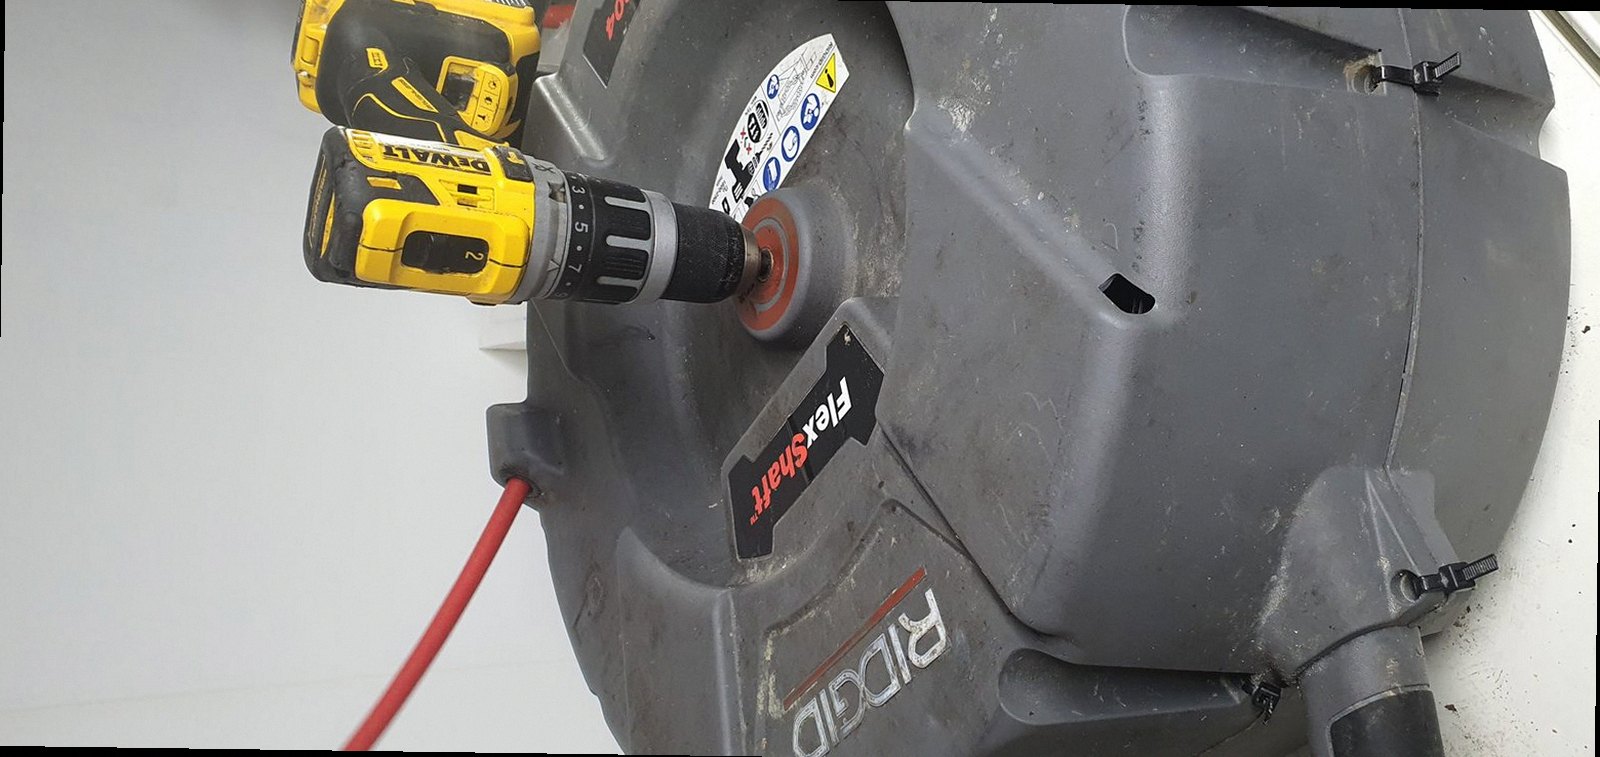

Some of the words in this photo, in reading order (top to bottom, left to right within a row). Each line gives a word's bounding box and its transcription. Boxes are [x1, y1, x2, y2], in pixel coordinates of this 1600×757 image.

[605, 0, 631, 41] 04
[383, 145, 491, 173] DEWALT
[571, 185, 586, 195] 3
[574, 221, 589, 233] 5
[464, 250, 484, 261] 2
[568, 263, 583, 274] 7
[751, 376, 852, 515] FlexShaft
[793, 588, 947, 757] RIDGID
